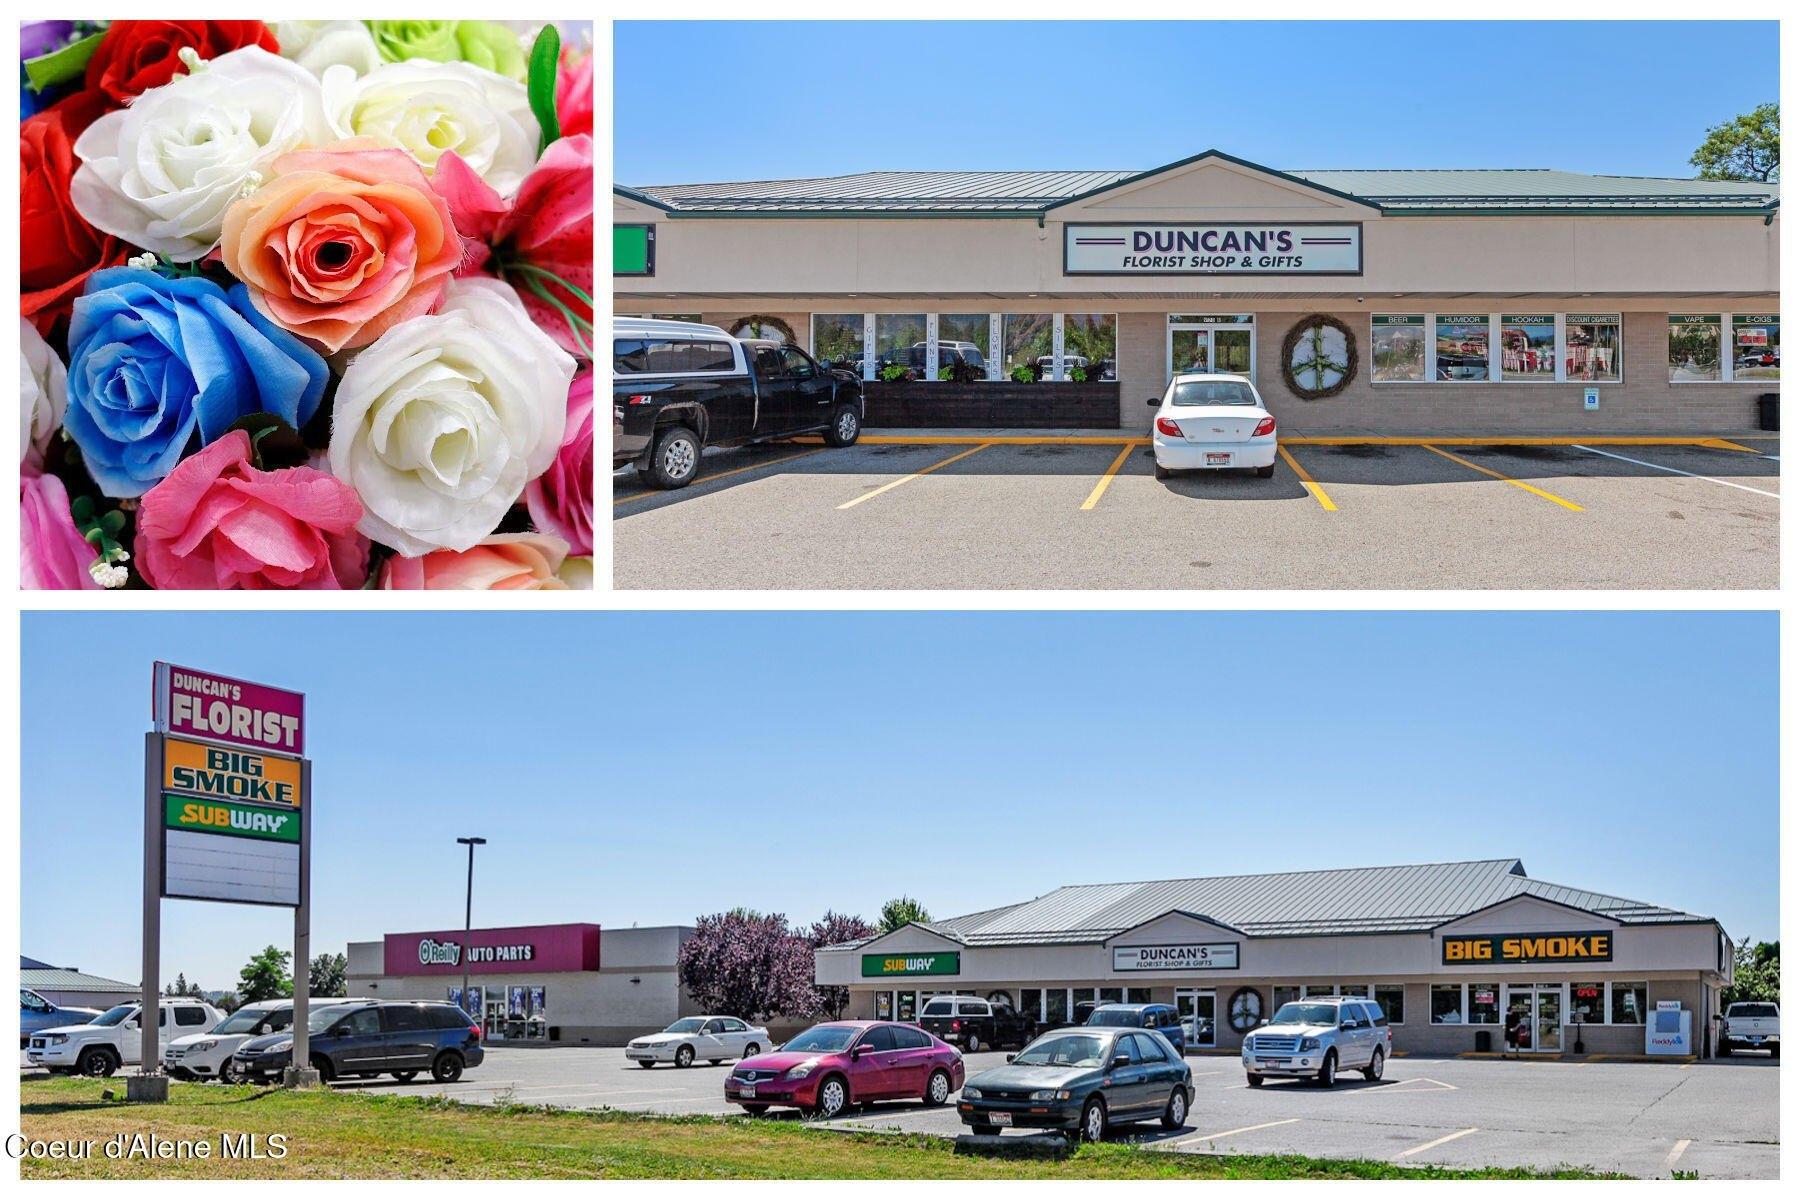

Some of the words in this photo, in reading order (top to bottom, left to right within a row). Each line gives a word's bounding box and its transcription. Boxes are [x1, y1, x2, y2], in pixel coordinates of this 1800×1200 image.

[1133, 230, 1294, 253] DUNCAN'S
[1123, 256, 1185, 268] FLORIST
[1190, 256, 1235, 268] SHOP
[1241, 256, 1252, 268] &
[1259, 256, 1303, 268] GIFTS
[174, 672, 242, 702] DUNCAN'S
[172, 693, 299, 747] FLORIST
[207, 747, 264, 777] BIG
[172, 766, 293, 804] SMOKE
[179, 803, 288, 833] SUBWAY
[419, 938, 461, 966] O'Reilly
[496, 945, 532, 961] PARTS
[1140, 947, 1208, 960] DUNCAN'S
[1445, 940, 1492, 961] BIG
[1502, 936, 1608, 959] SMOKE
[883, 957, 935, 972] SUBWAY
[1136, 960, 1162, 968] FLORIST
[1192, 959, 1213, 967] GIFTS
[1577, 988, 1598, 997] OPEN
